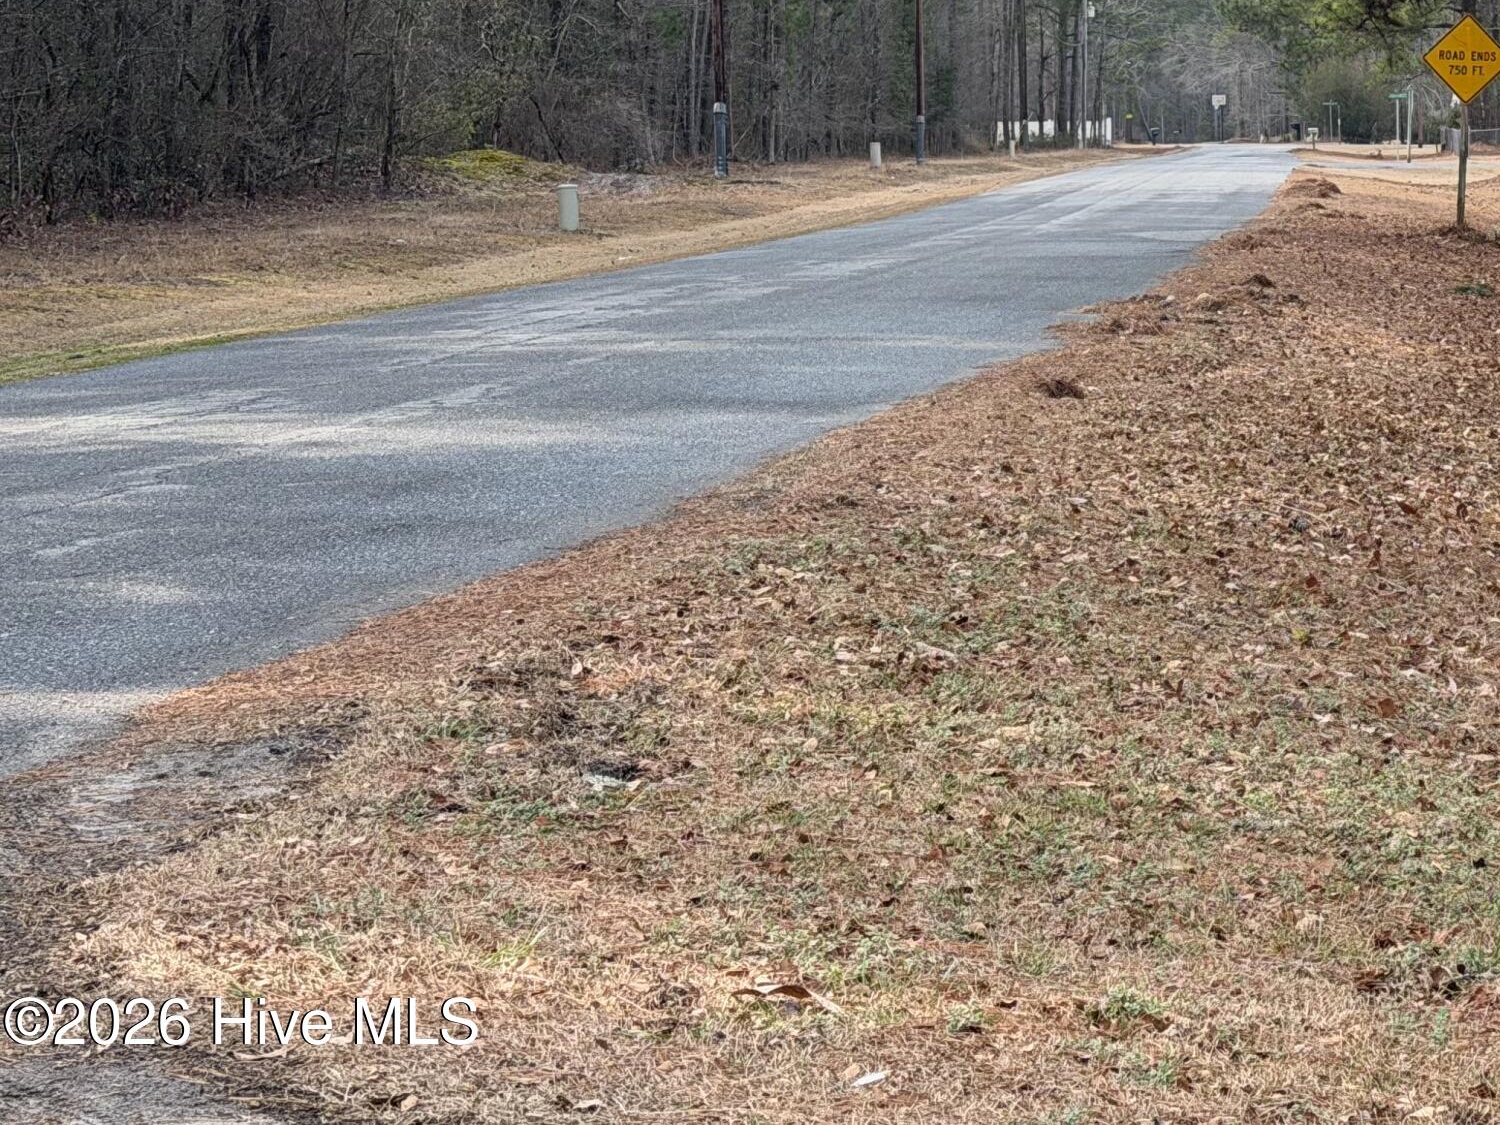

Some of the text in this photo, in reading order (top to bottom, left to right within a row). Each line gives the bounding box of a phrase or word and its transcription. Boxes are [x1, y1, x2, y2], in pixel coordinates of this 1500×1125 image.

[1439, 50, 1496, 62] ROAD ENDS
[1449, 65, 1467, 75] 750
